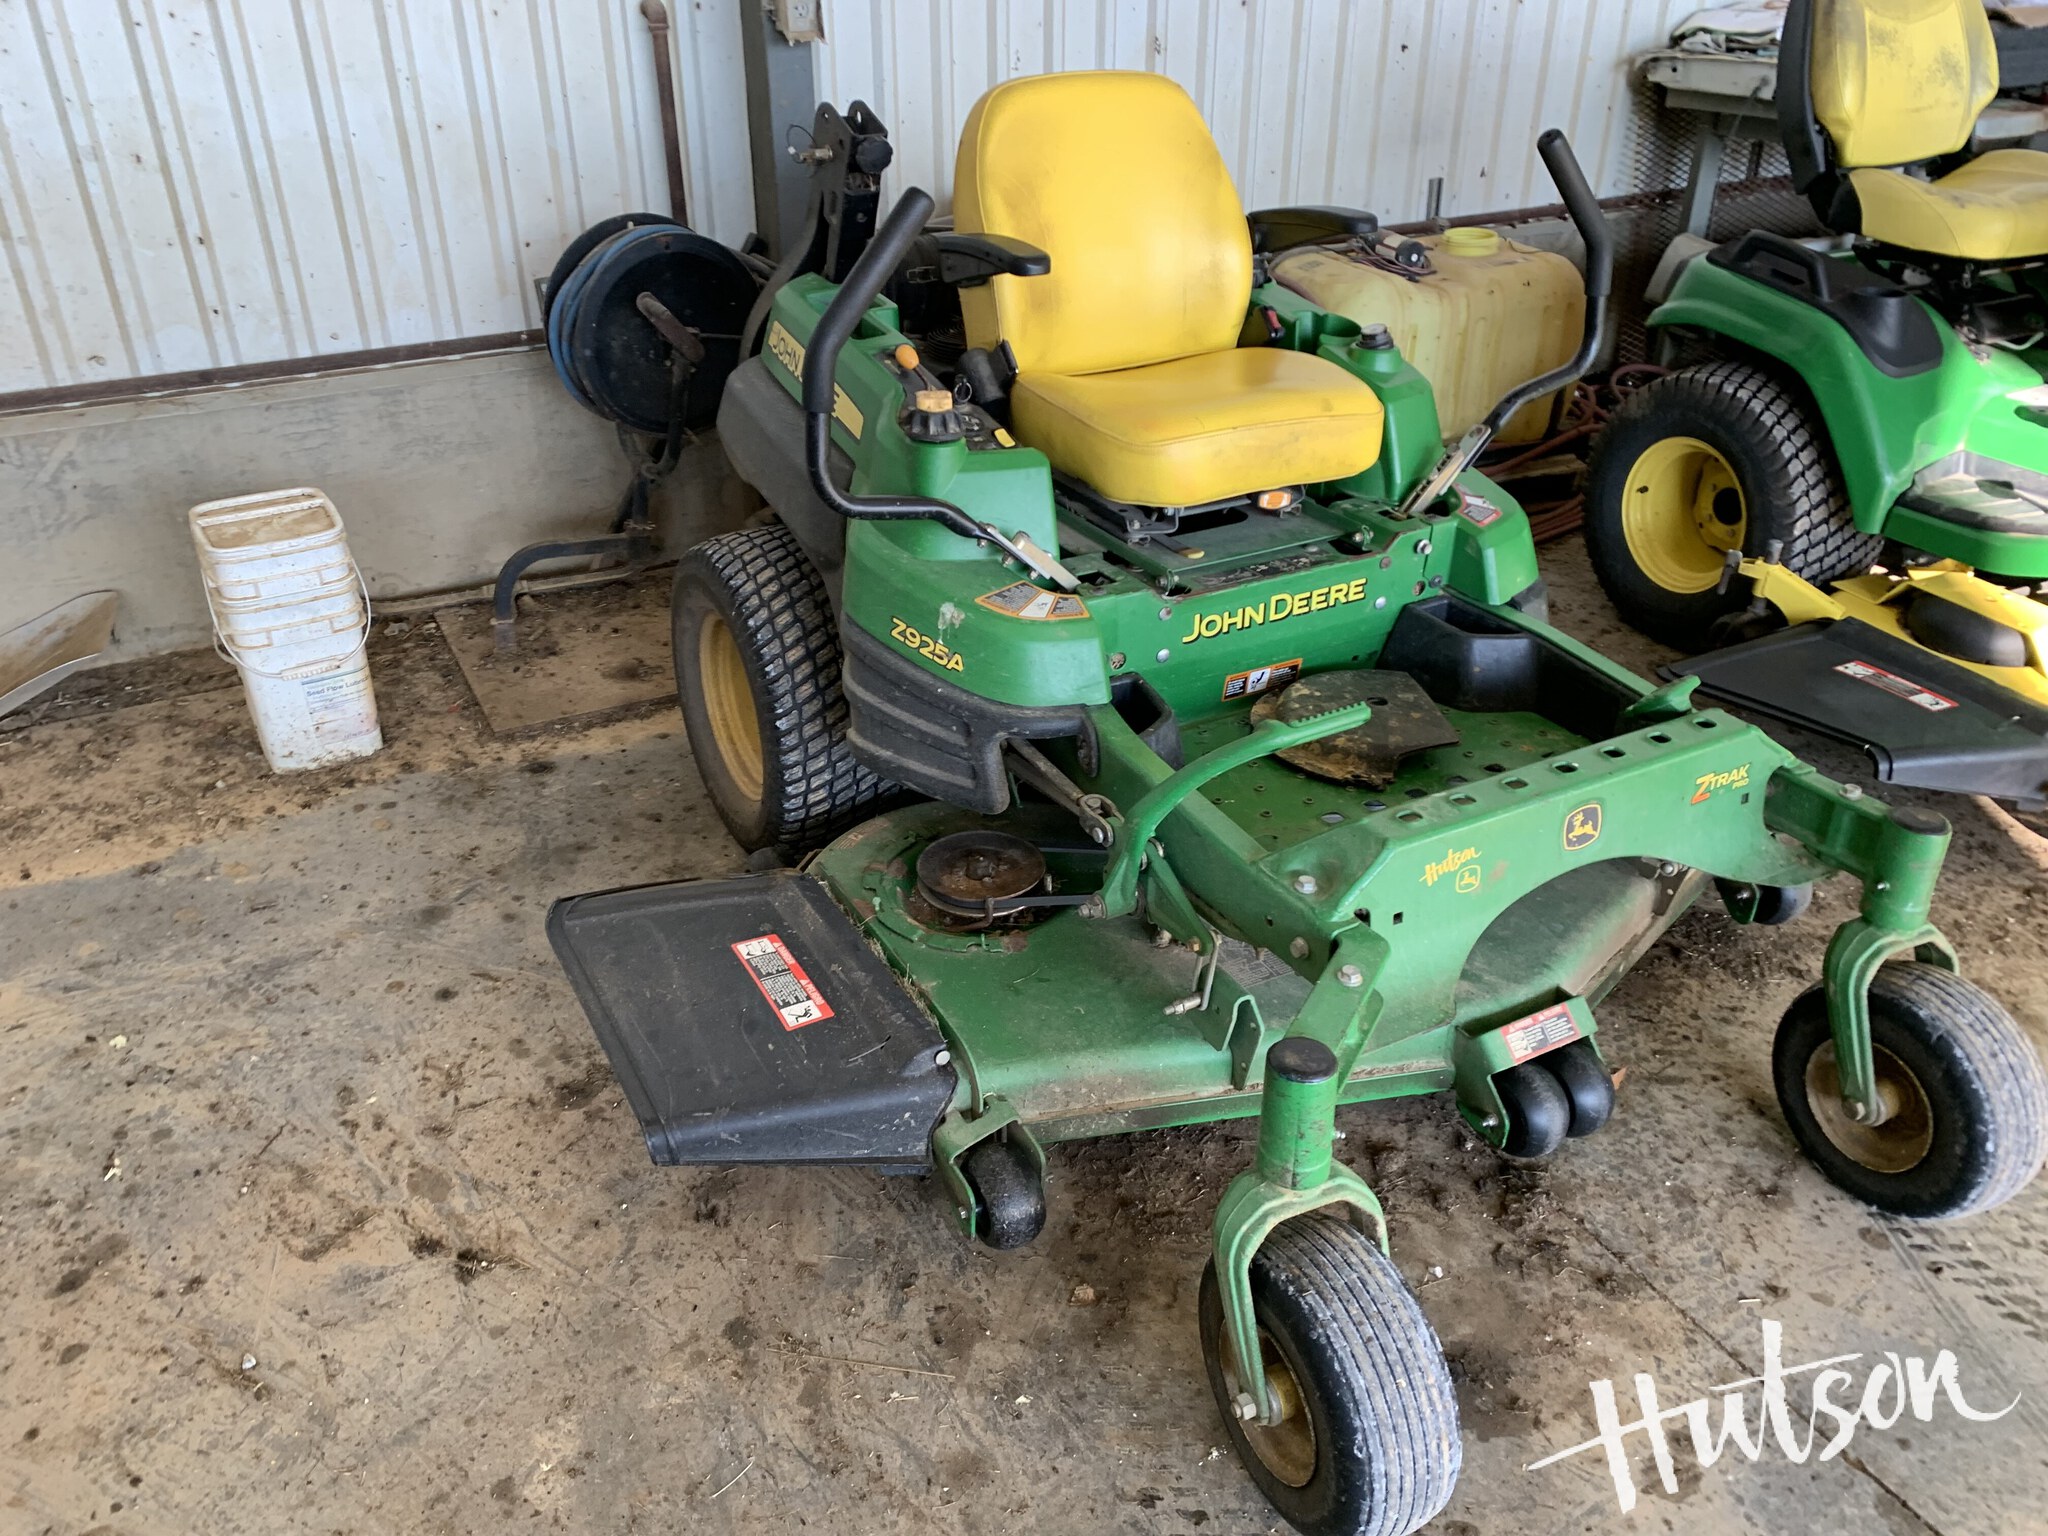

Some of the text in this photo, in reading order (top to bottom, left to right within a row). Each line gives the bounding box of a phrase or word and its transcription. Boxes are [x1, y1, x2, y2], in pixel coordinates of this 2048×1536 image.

[772, 329, 801, 371] JOHN
[1181, 577, 1368, 644] JOHN DEERE
[890, 616, 966, 673] Z925A
[1418, 846, 1483, 887] Hutson
